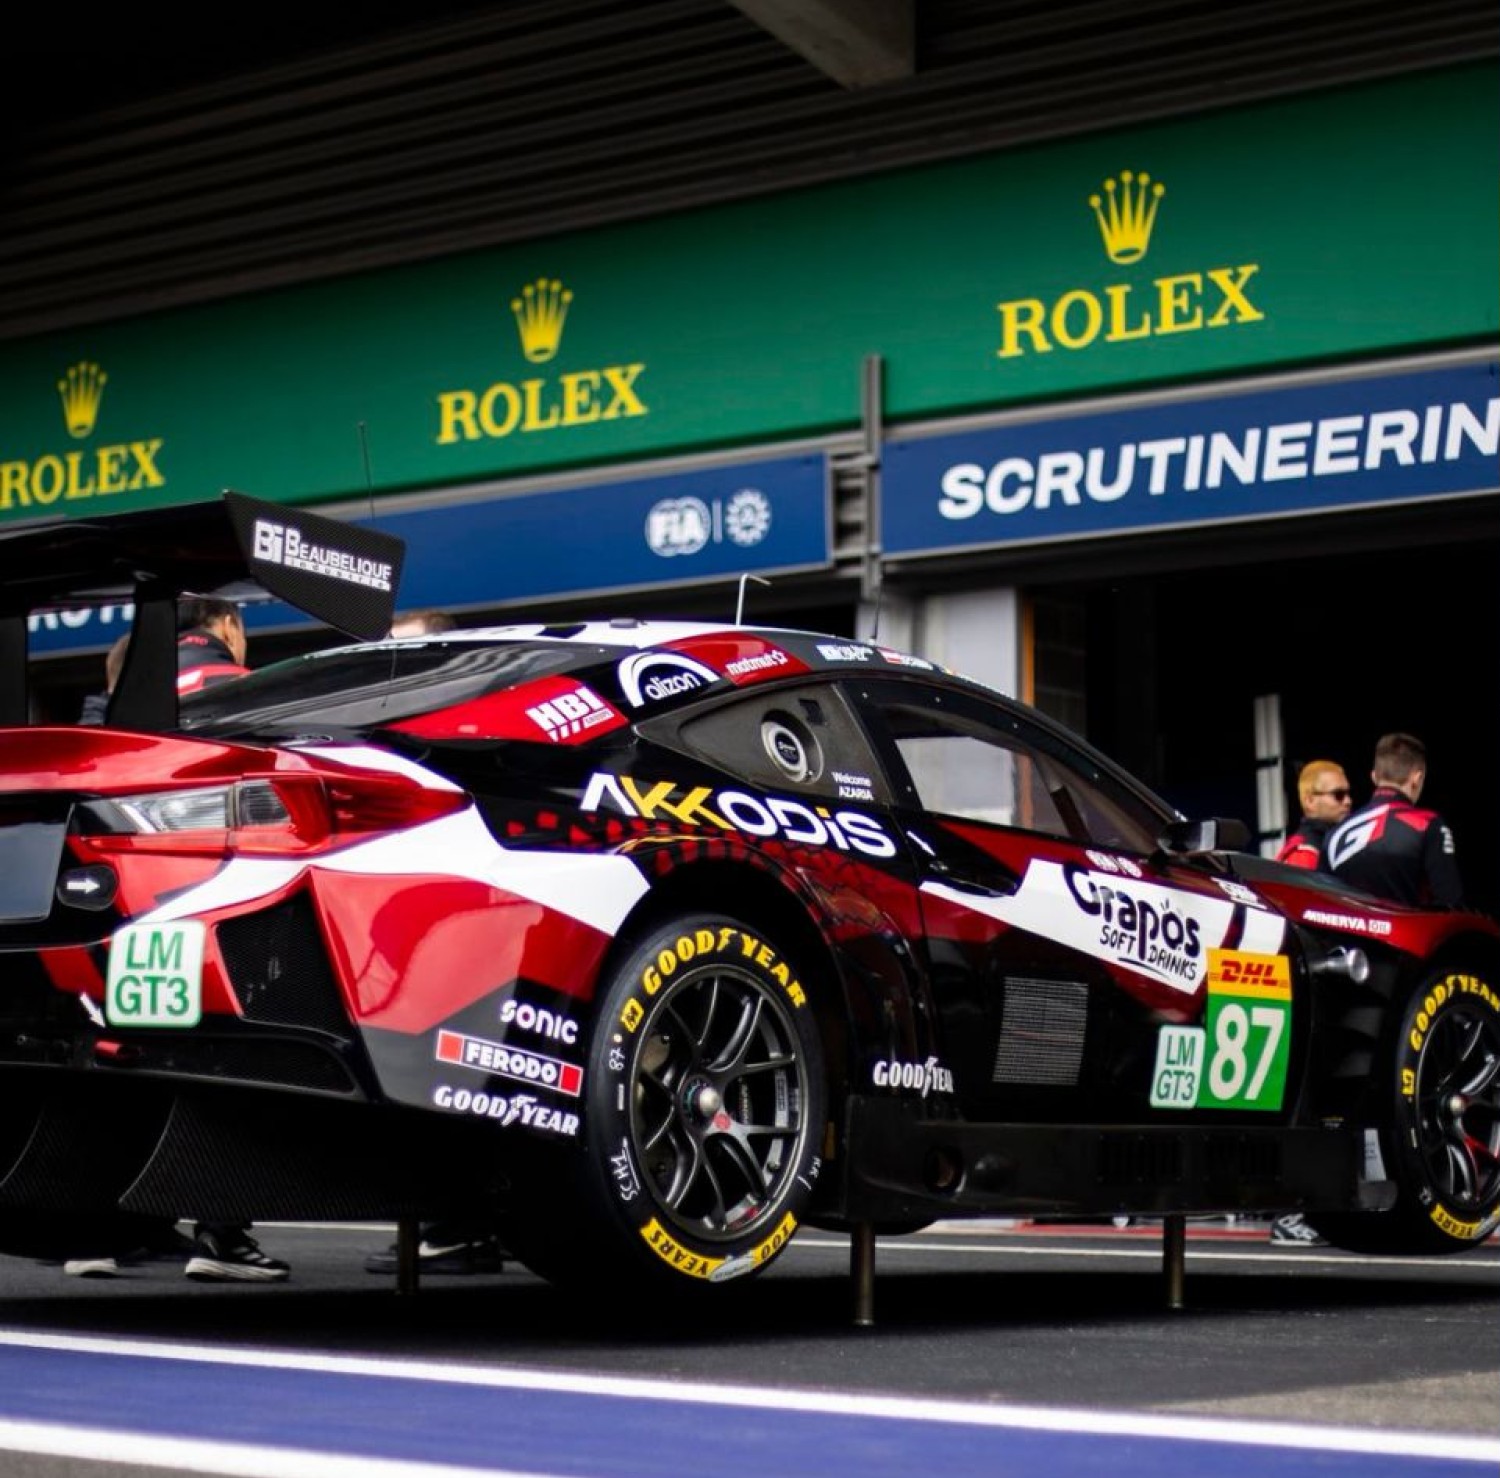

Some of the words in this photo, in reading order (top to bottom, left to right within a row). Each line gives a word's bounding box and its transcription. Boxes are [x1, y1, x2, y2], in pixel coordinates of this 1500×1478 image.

[997, 263, 1264, 357] ROLEX
[436, 363, 648, 445] ROLEX
[0, 438, 165, 510] ROLEX
[938, 397, 1500, 520] SCRUTINEERIN
[1303, 909, 1367, 931] MINERVA
[125, 931, 184, 970] LM
[1099, 924, 1137, 955] SOFT
[1147, 945, 1198, 981] DRINKS
[1220, 960, 1278, 986] DHL
[115, 974, 190, 1016] GT3
[465, 1040, 557, 1083] FERODO
[1166, 1035, 1196, 1067] LM
[1208, 1003, 1285, 1101] 87
[1155, 1069, 1195, 1101] GT3
[433, 1085, 580, 1136] GOODYEAR
[650, 1230, 710, 1277] YEARS
